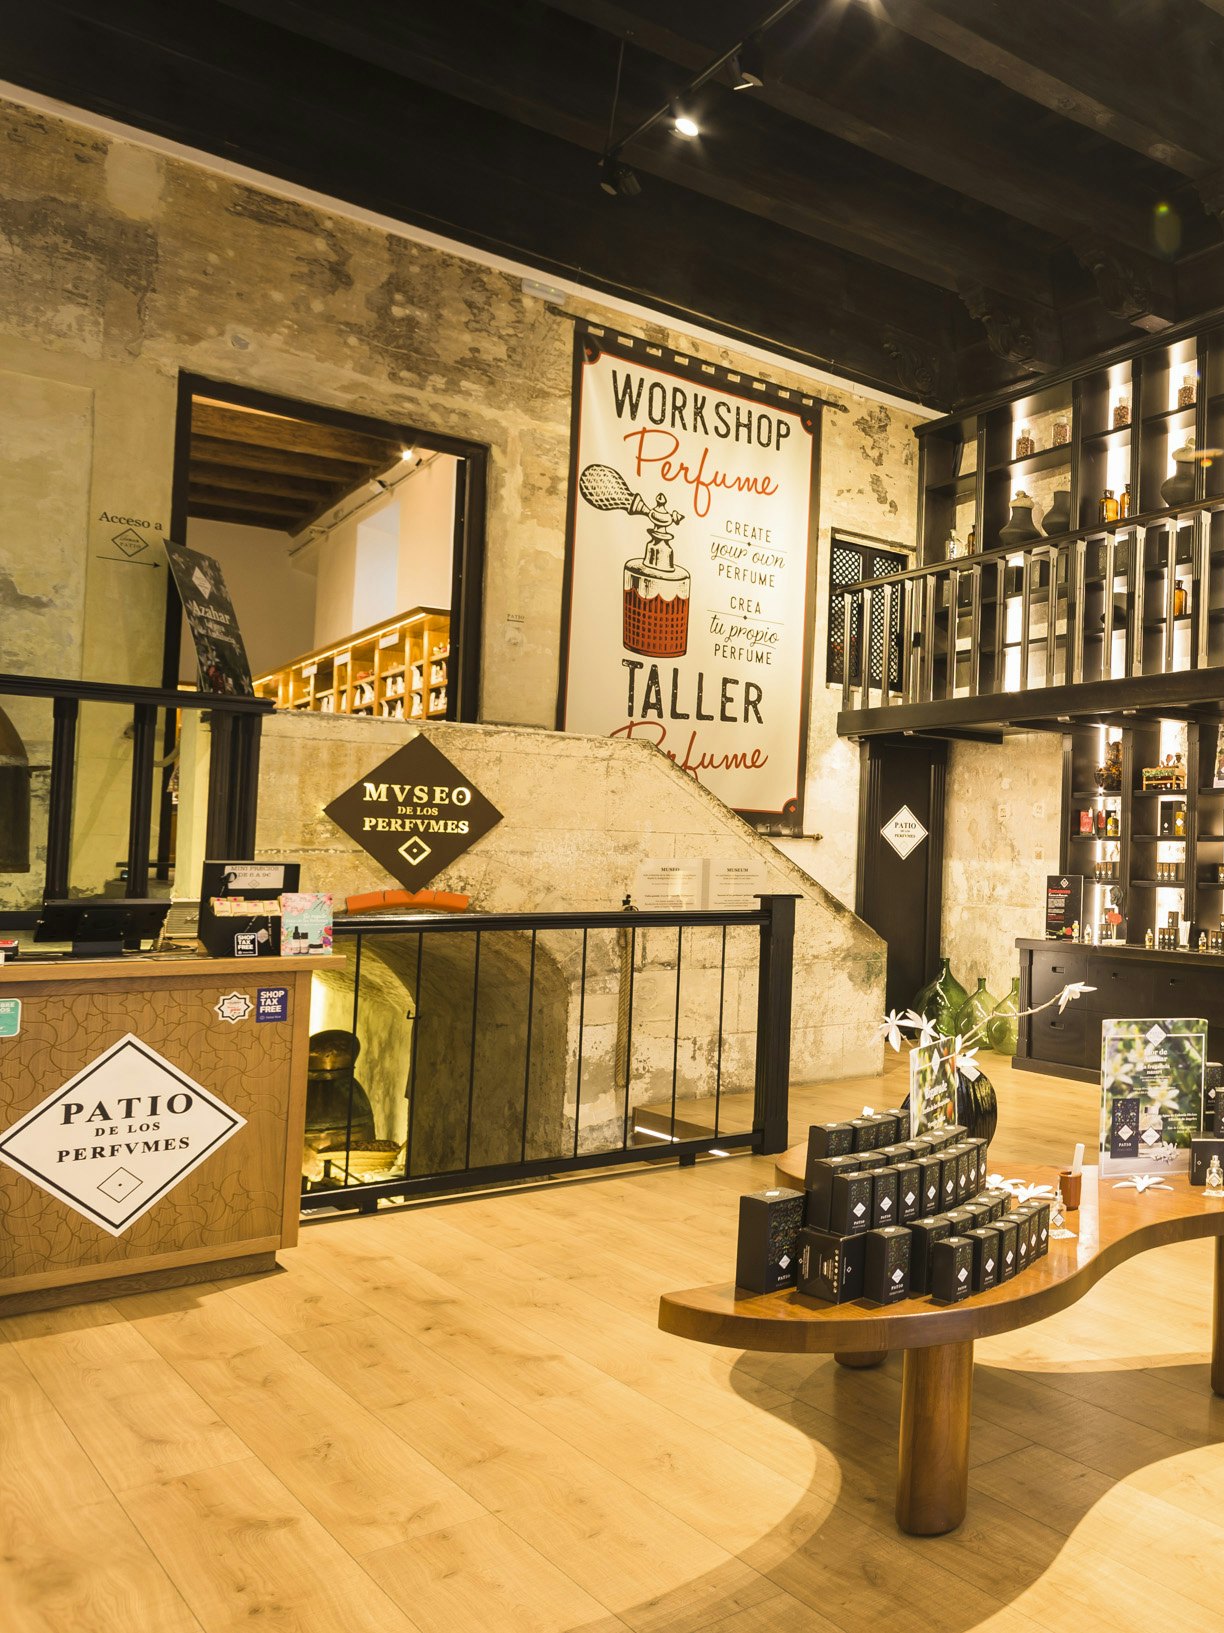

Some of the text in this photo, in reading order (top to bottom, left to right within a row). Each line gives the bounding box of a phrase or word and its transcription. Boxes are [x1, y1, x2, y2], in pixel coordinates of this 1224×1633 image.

[612, 370, 790, 451] WORKSHOP
[623, 427, 779, 517] Perfume
[99, 511, 163, 531] Acceso a
[726, 520, 771, 543] CREATE
[710, 542, 785, 569] your own
[718, 563, 775, 588] PERFUME
[730, 596, 762, 615] CREA
[709, 614, 780, 650] tu propio
[714, 643, 772, 665] PERFUME
[621, 658, 764, 724] TALLER
[363, 782, 471, 806] MVSEO
[397, 806, 439, 816] DE LOS
[363, 817, 470, 834] PERFVMES
[894, 821, 917, 829] PATIO
[260, 990, 285, 998] SHOP
[260, 998, 278, 1006] TAX
[260, 1005, 282, 1013] FREE
[59, 1093, 193, 1126] PATIO
[94, 1121, 161, 1137] DE LOS
[56, 1136, 190, 1163] PERFVMES
